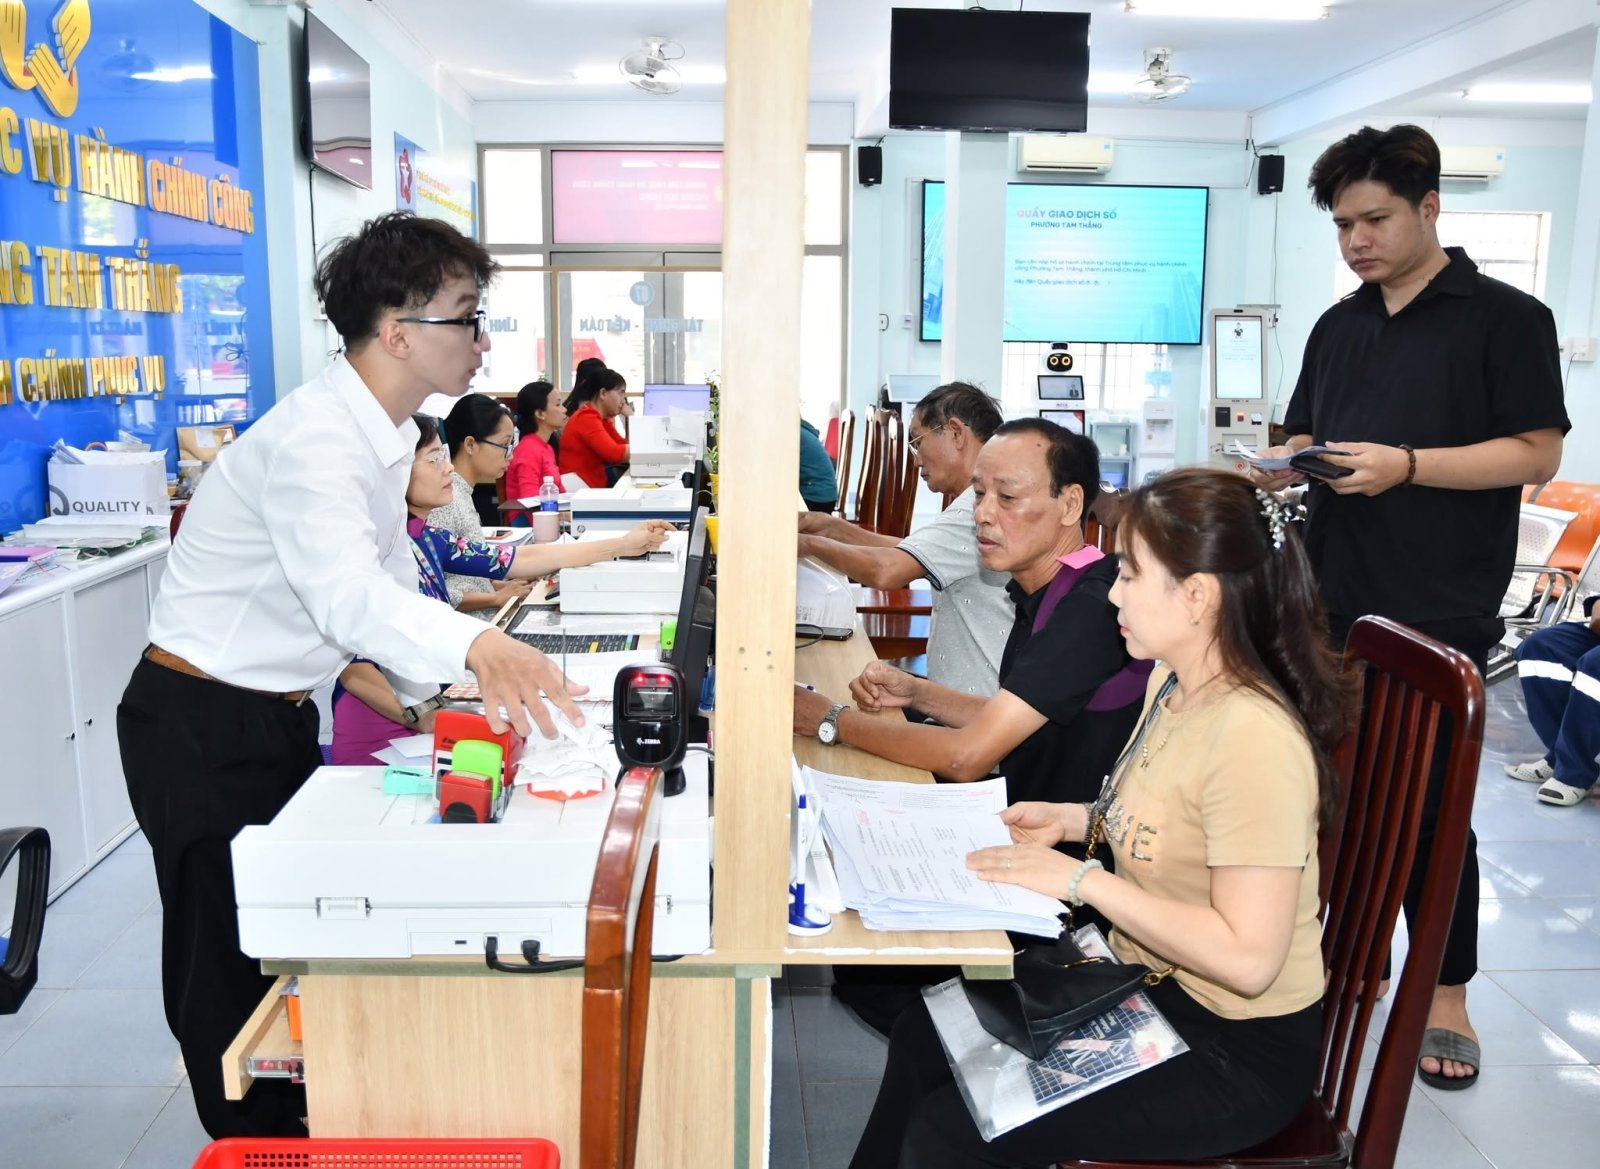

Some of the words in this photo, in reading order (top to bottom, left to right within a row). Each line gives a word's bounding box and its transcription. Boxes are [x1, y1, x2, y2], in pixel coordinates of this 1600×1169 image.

[24, 116, 72, 202] VỤ
[74, 126, 146, 206] HÀNH
[147, 156, 208, 222] CHÍNH
[208, 172, 254, 234] CÔNG
[1016, 207, 1046, 218] QUẤY
[1049, 210, 1074, 218] GIAO
[1076, 210, 1100, 220] DỊCH
[1103, 208, 1117, 219] SỐ
[1078, 220, 1102, 229] THẮNG
[36, 245, 104, 309] TAM
[105, 238, 183, 314] THẮNG
[15, 348, 86, 404] CHÍNH
[139, 355, 166, 400] VỤ
[72, 501, 140, 514] QUALITY
